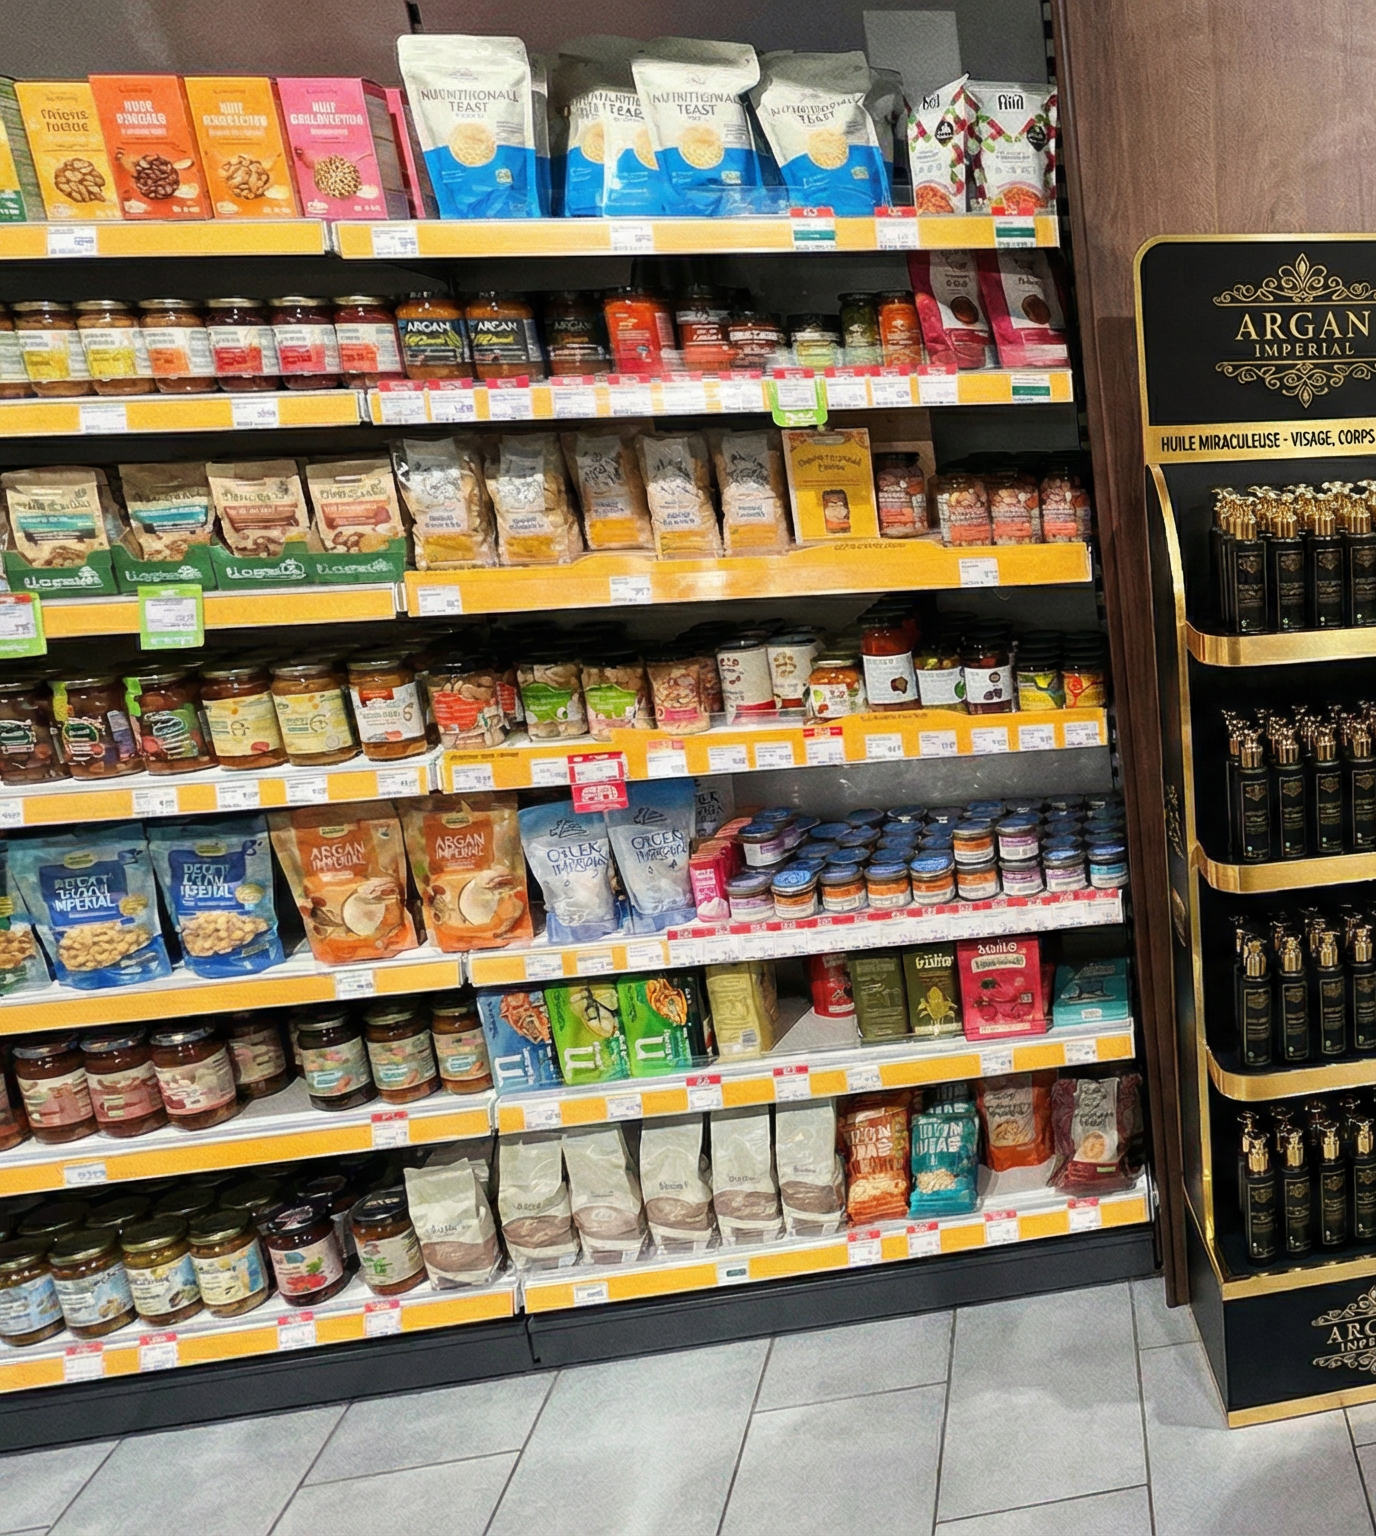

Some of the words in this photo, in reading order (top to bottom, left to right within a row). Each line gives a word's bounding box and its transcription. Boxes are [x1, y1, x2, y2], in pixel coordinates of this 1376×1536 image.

[1235, 310, 1371, 341] ARGAN
[1255, 342, 1355, 358] IMPERIAL
[1161, 435, 1196, 452] HUILE
[1199, 432, 1280, 451] MIRACULEUSE
[1291, 430, 1336, 447] VISAGE,
[1338, 429, 1376, 445] CORPS
